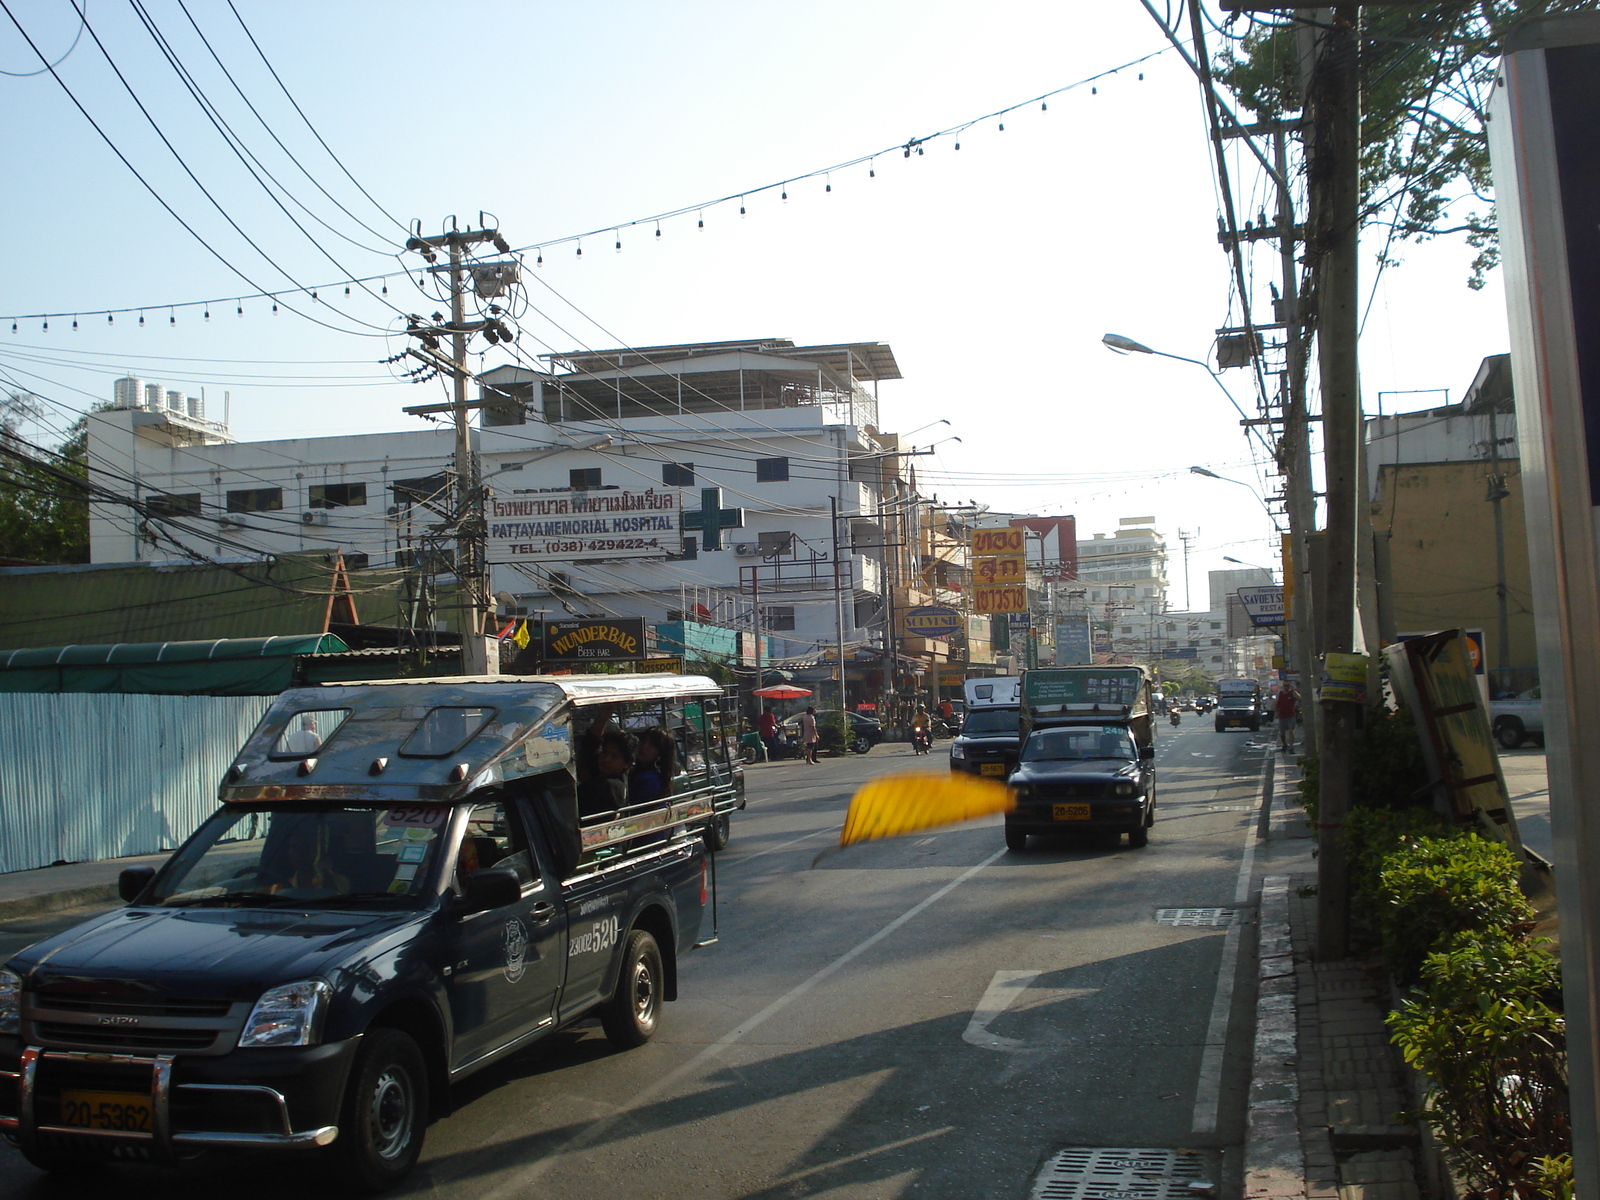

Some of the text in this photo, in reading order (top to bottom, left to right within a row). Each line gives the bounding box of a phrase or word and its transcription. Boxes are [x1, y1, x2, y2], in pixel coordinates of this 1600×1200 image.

[491, 488, 673, 517] โรงพยาบาล พทยาเมโมเรียล
[613, 515, 673, 533] HOSPITAL
[509, 537, 658, 555] TEL. (038) 429422-4
[974, 531, 1021, 551] ทอง
[979, 558, 1018, 583] สุก
[552, 626, 636, 655] WUNDERBAR
[1105, 727, 1124, 735] 249
[390, 805, 441, 825] 520
[1054, 806, 1089, 817] 20-5205
[592, 915, 619, 953] 520
[65, 1101, 152, 1131] 20-5362
